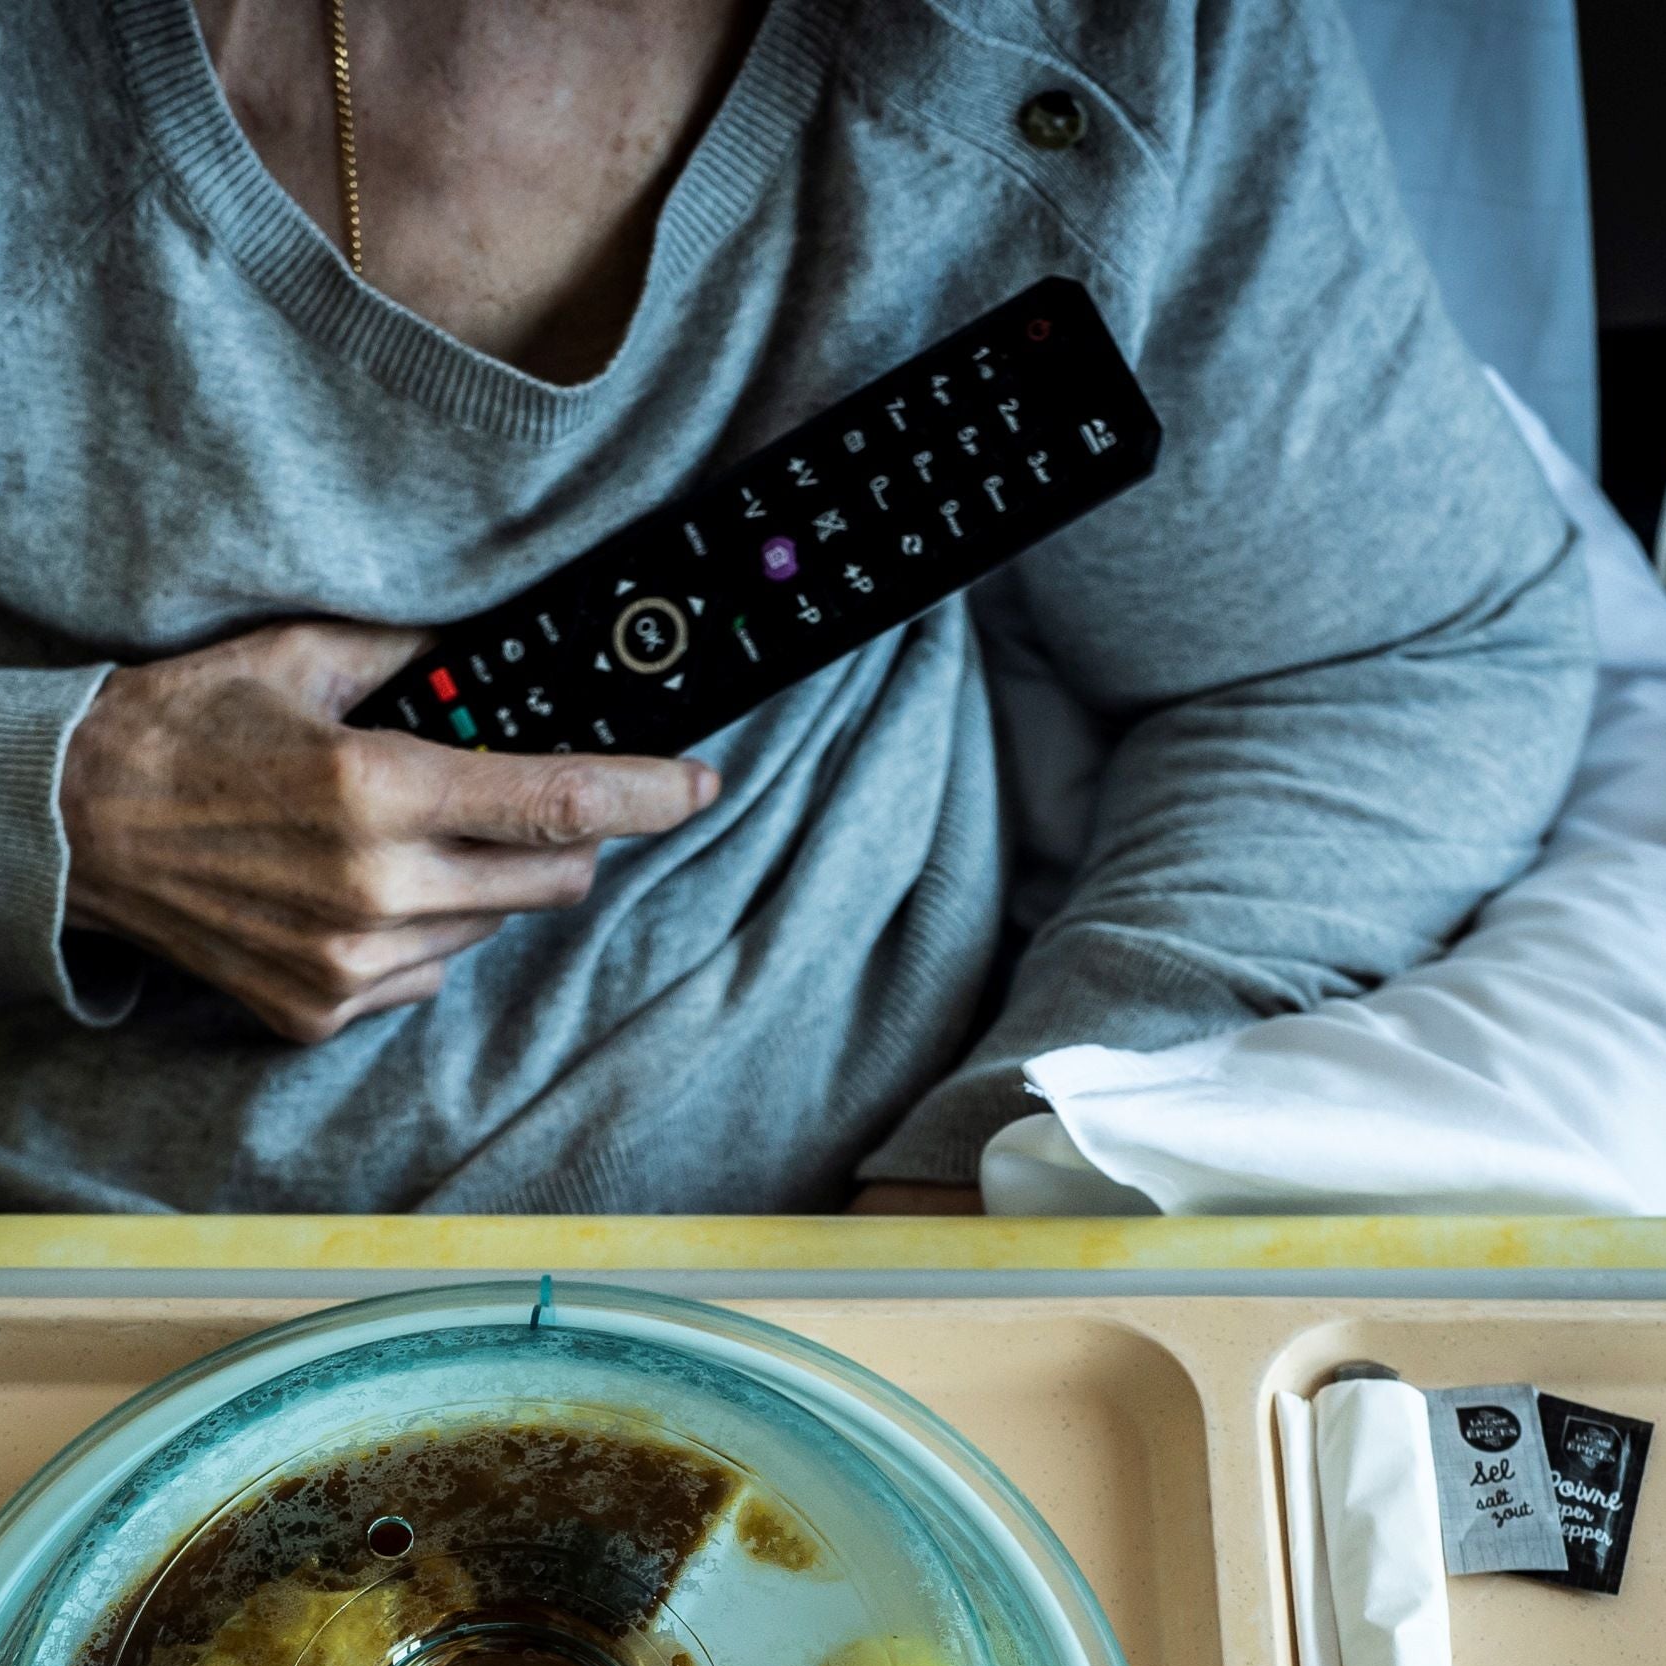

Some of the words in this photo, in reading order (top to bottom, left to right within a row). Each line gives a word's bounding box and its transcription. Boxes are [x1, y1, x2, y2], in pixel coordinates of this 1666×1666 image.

[635, 616, 667, 653] OK
[1470, 1459, 1515, 1486] Sel
[1476, 1488, 1514, 1510] salt
[1492, 1502, 1534, 1528] zout
[1562, 1523, 1613, 1546] epper
